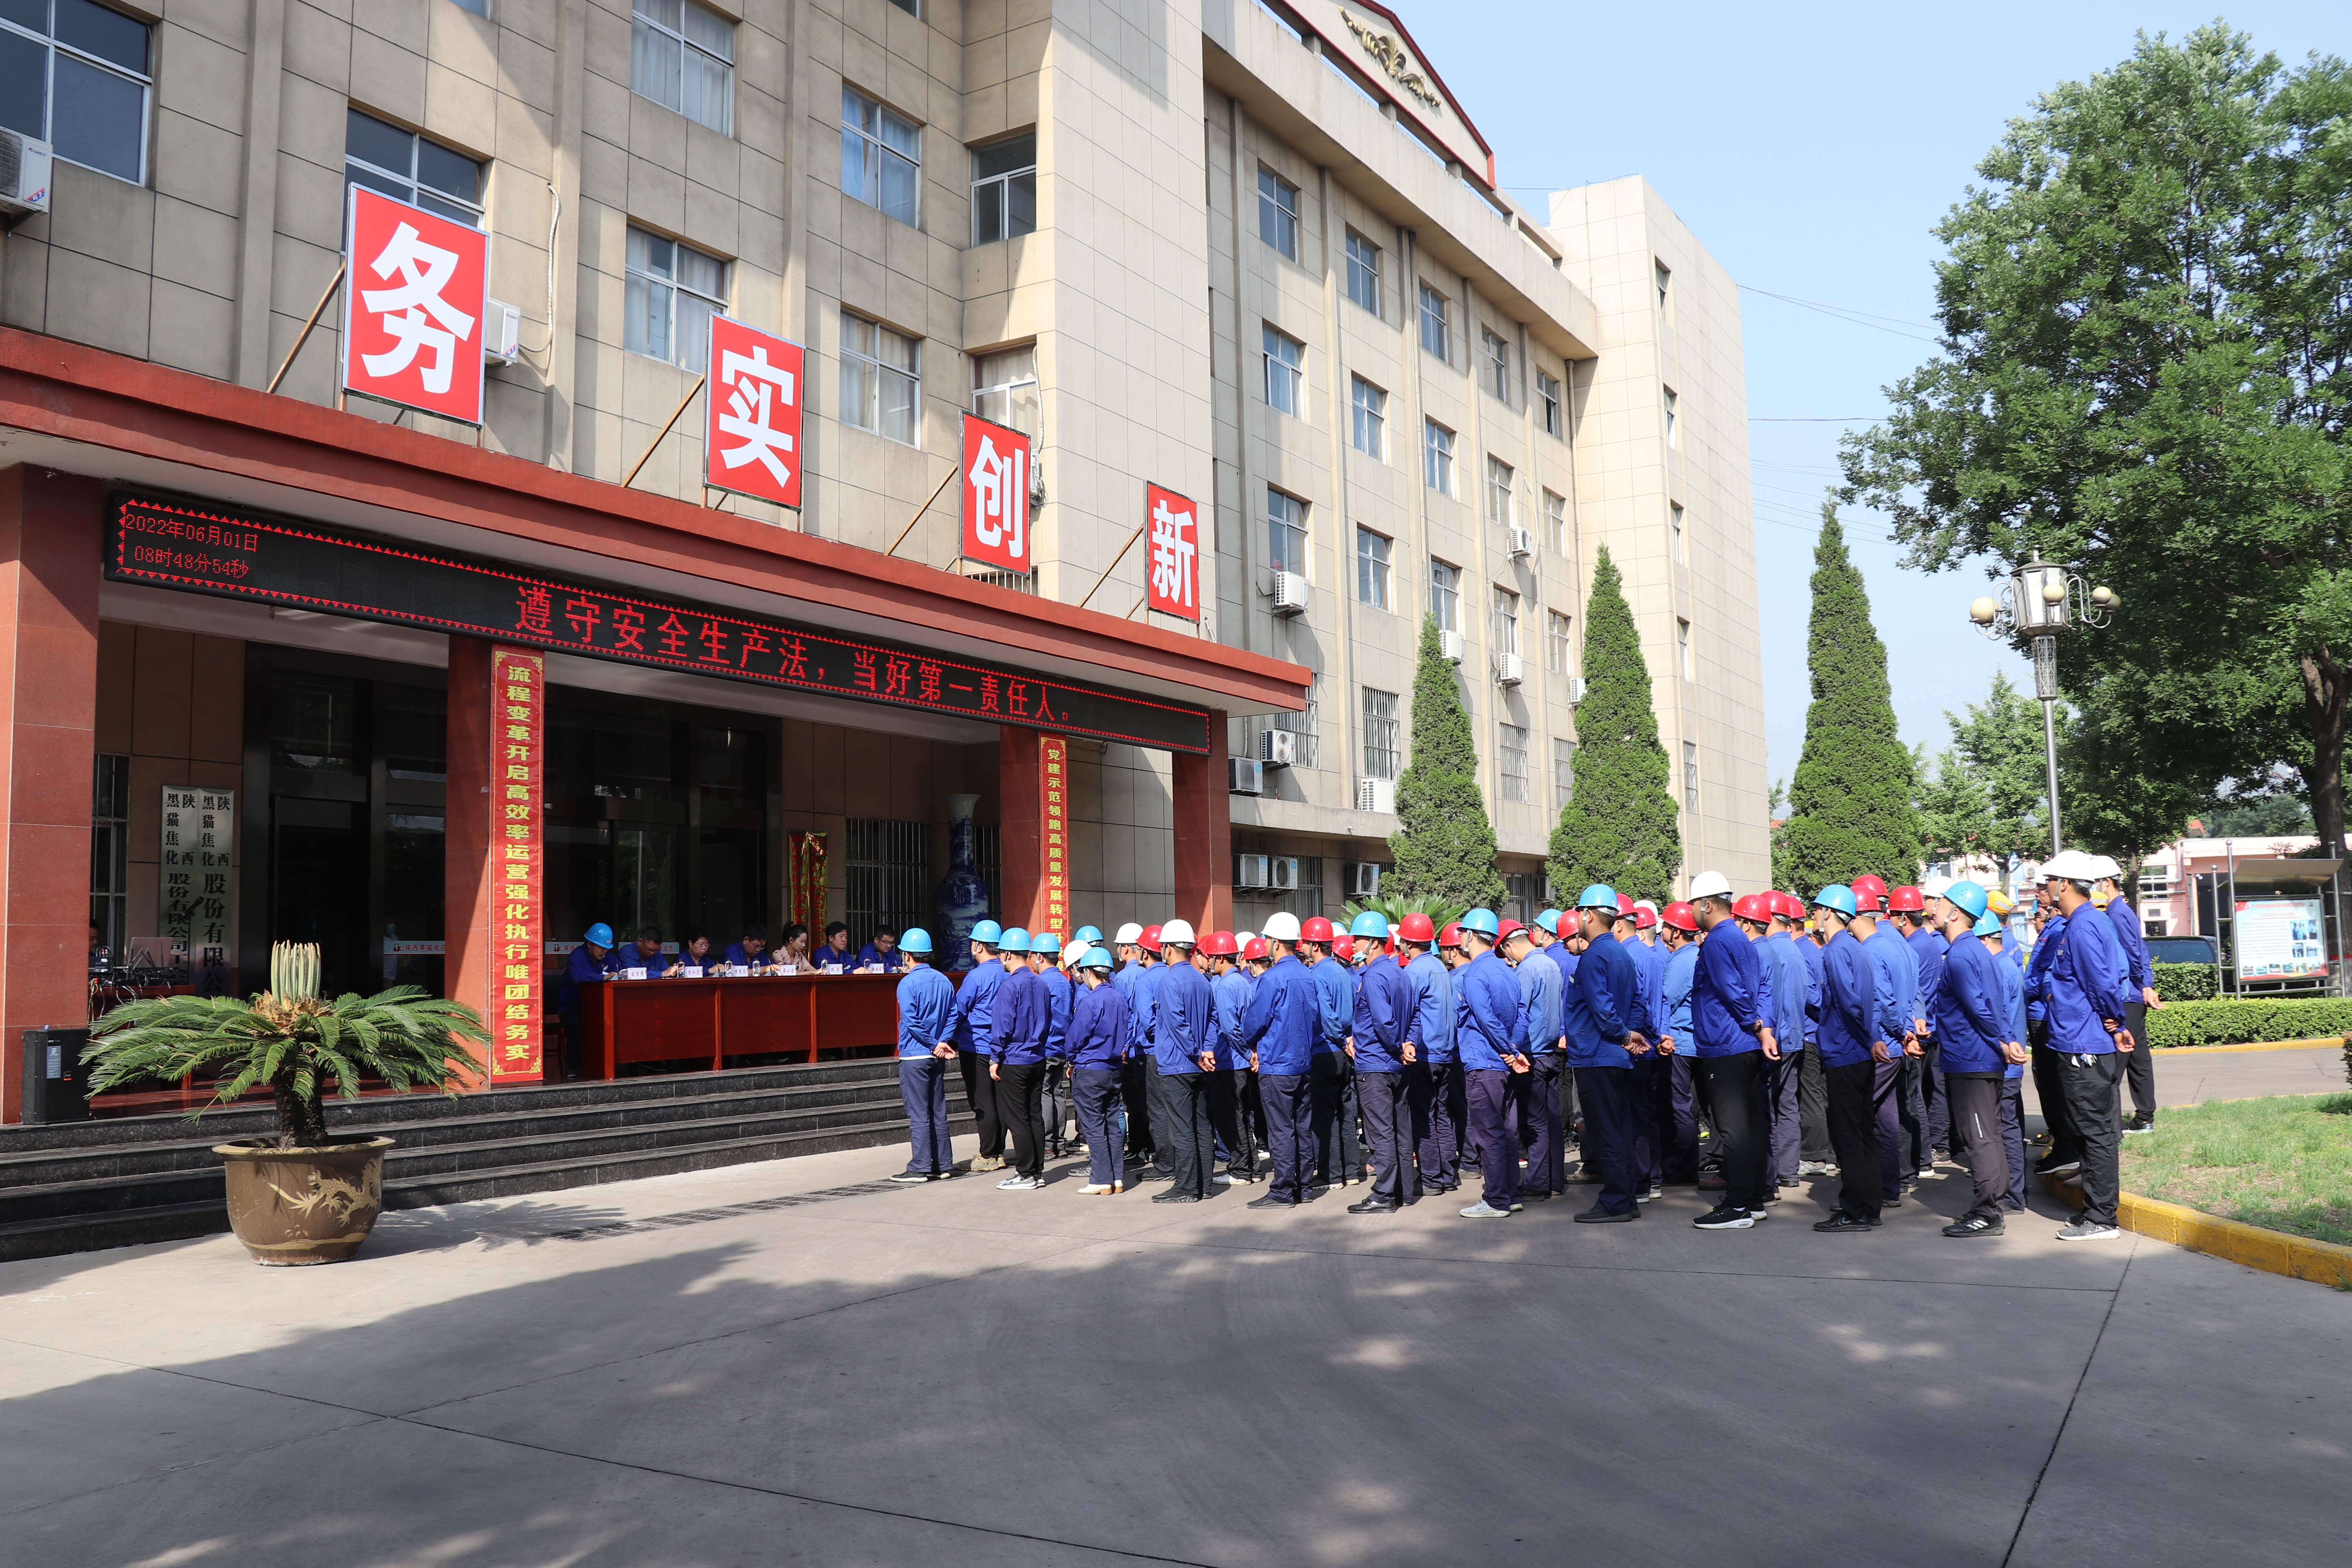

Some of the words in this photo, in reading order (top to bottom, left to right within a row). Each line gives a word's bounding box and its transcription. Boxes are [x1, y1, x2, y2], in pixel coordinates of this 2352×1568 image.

[361, 221, 475, 394] 务
[719, 345, 794, 488] 实
[125, 514, 258, 552] 2022年06月01日
[969, 434, 1024, 557] 创
[1152, 499, 1194, 607] 新
[134, 546, 249, 578] 08时48分54秒
[515, 586, 1069, 721] 遵守安全生产法，当好第一责任人。
[503, 665, 531, 1061] 流程变革开启高效率运营强化执行唯团结务实
